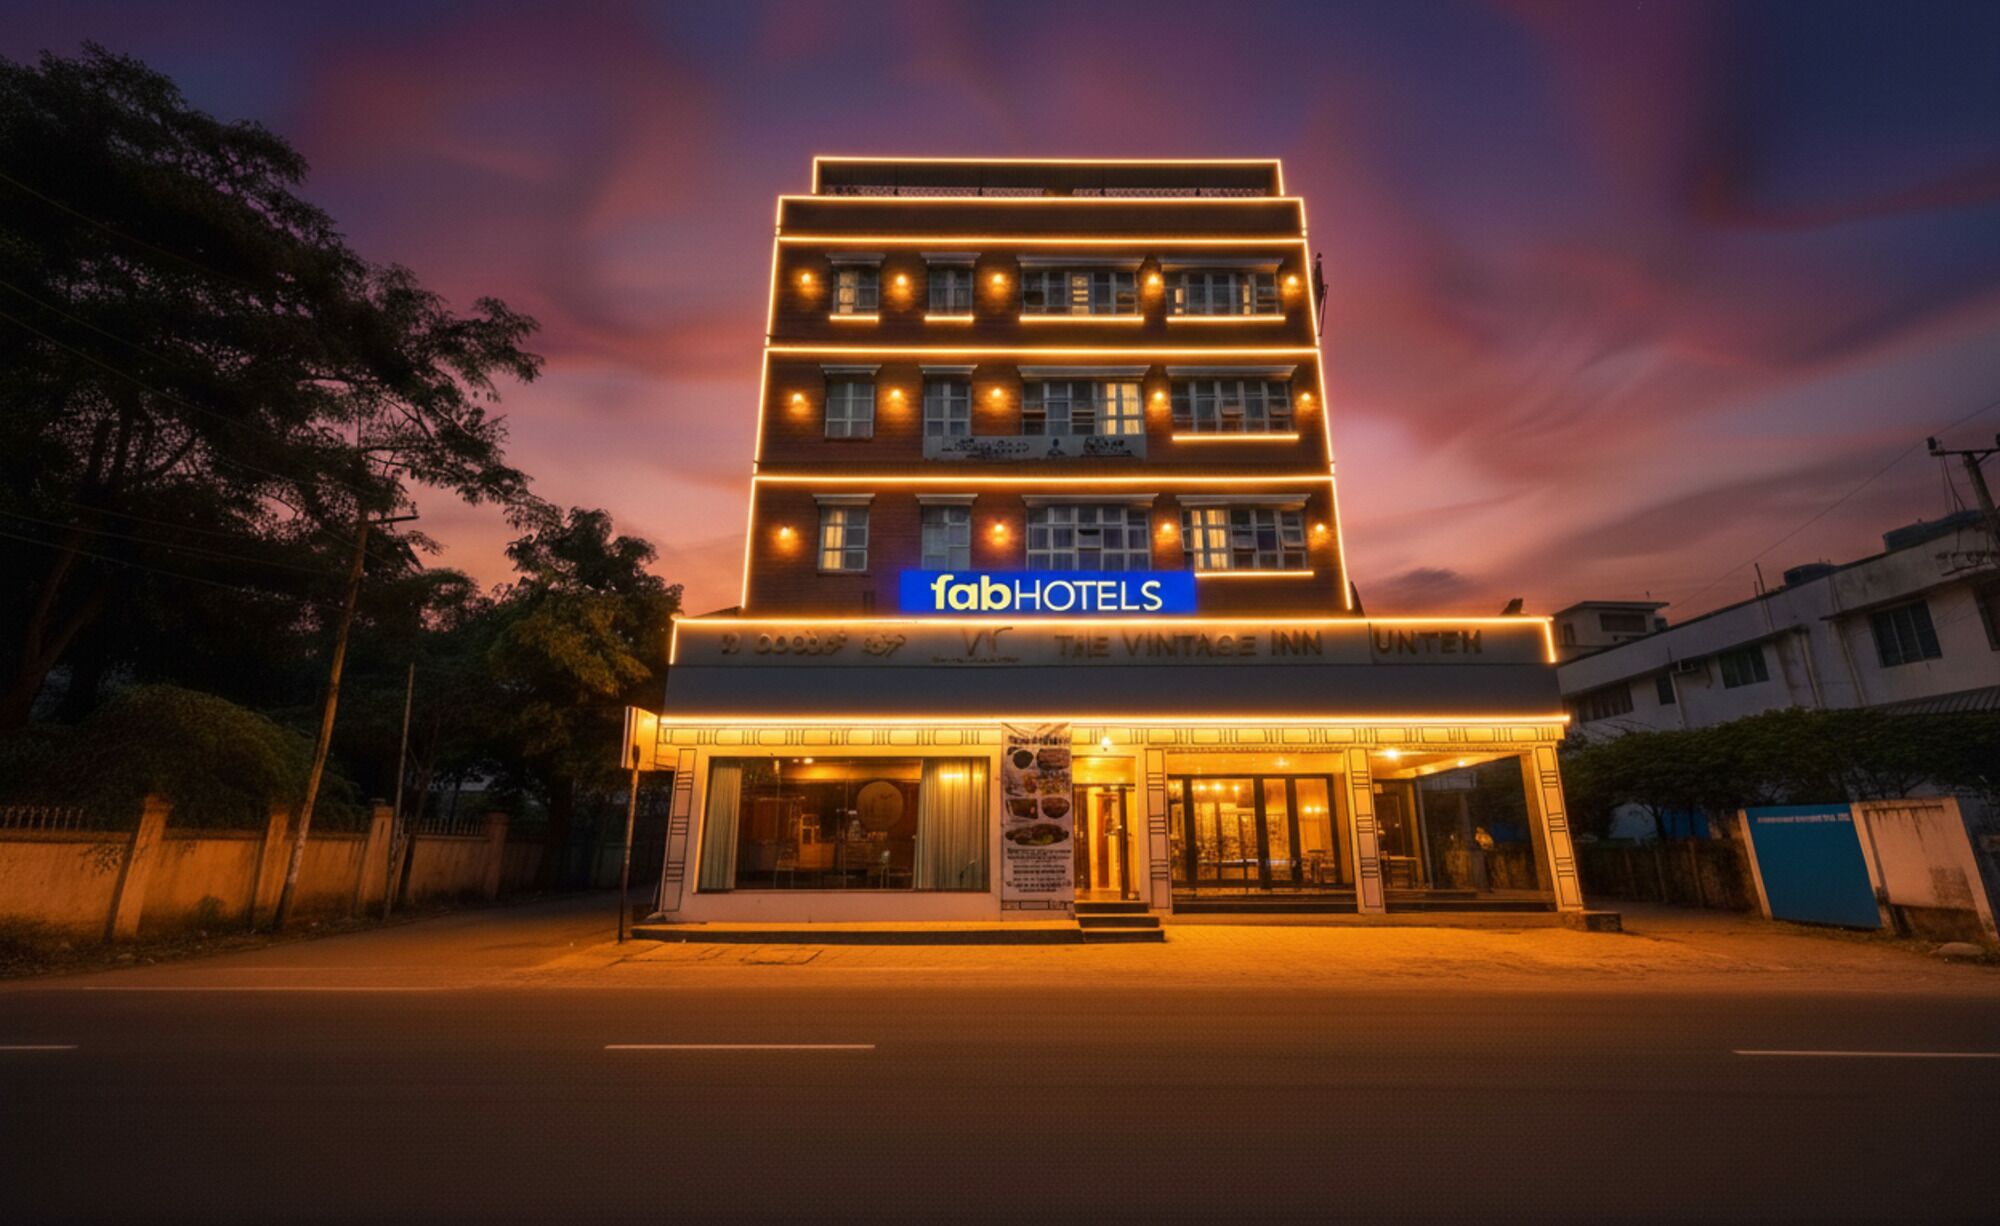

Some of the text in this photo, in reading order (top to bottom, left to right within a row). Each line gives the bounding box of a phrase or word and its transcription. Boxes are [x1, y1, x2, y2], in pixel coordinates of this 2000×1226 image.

[930, 574, 1163, 611] fabHOTELS
[1121, 629, 1257, 657] VINTAGE
[1271, 630, 1324, 656] INN
